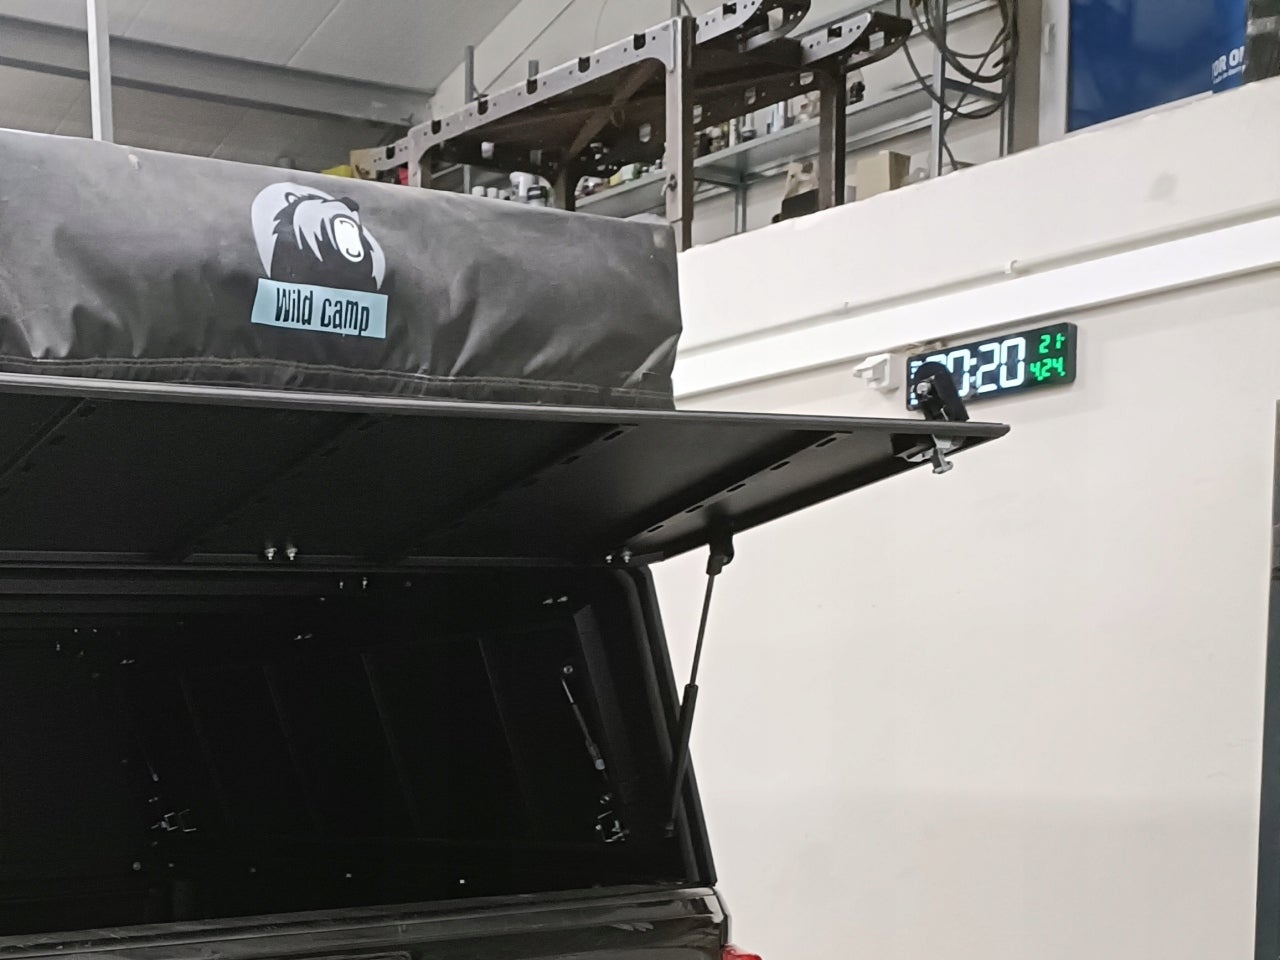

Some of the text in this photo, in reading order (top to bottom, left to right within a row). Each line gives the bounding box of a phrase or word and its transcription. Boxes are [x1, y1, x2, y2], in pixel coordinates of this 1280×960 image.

[275, 287, 370, 336] Wild camp
[925, 337, 1025, 397] 0:20
